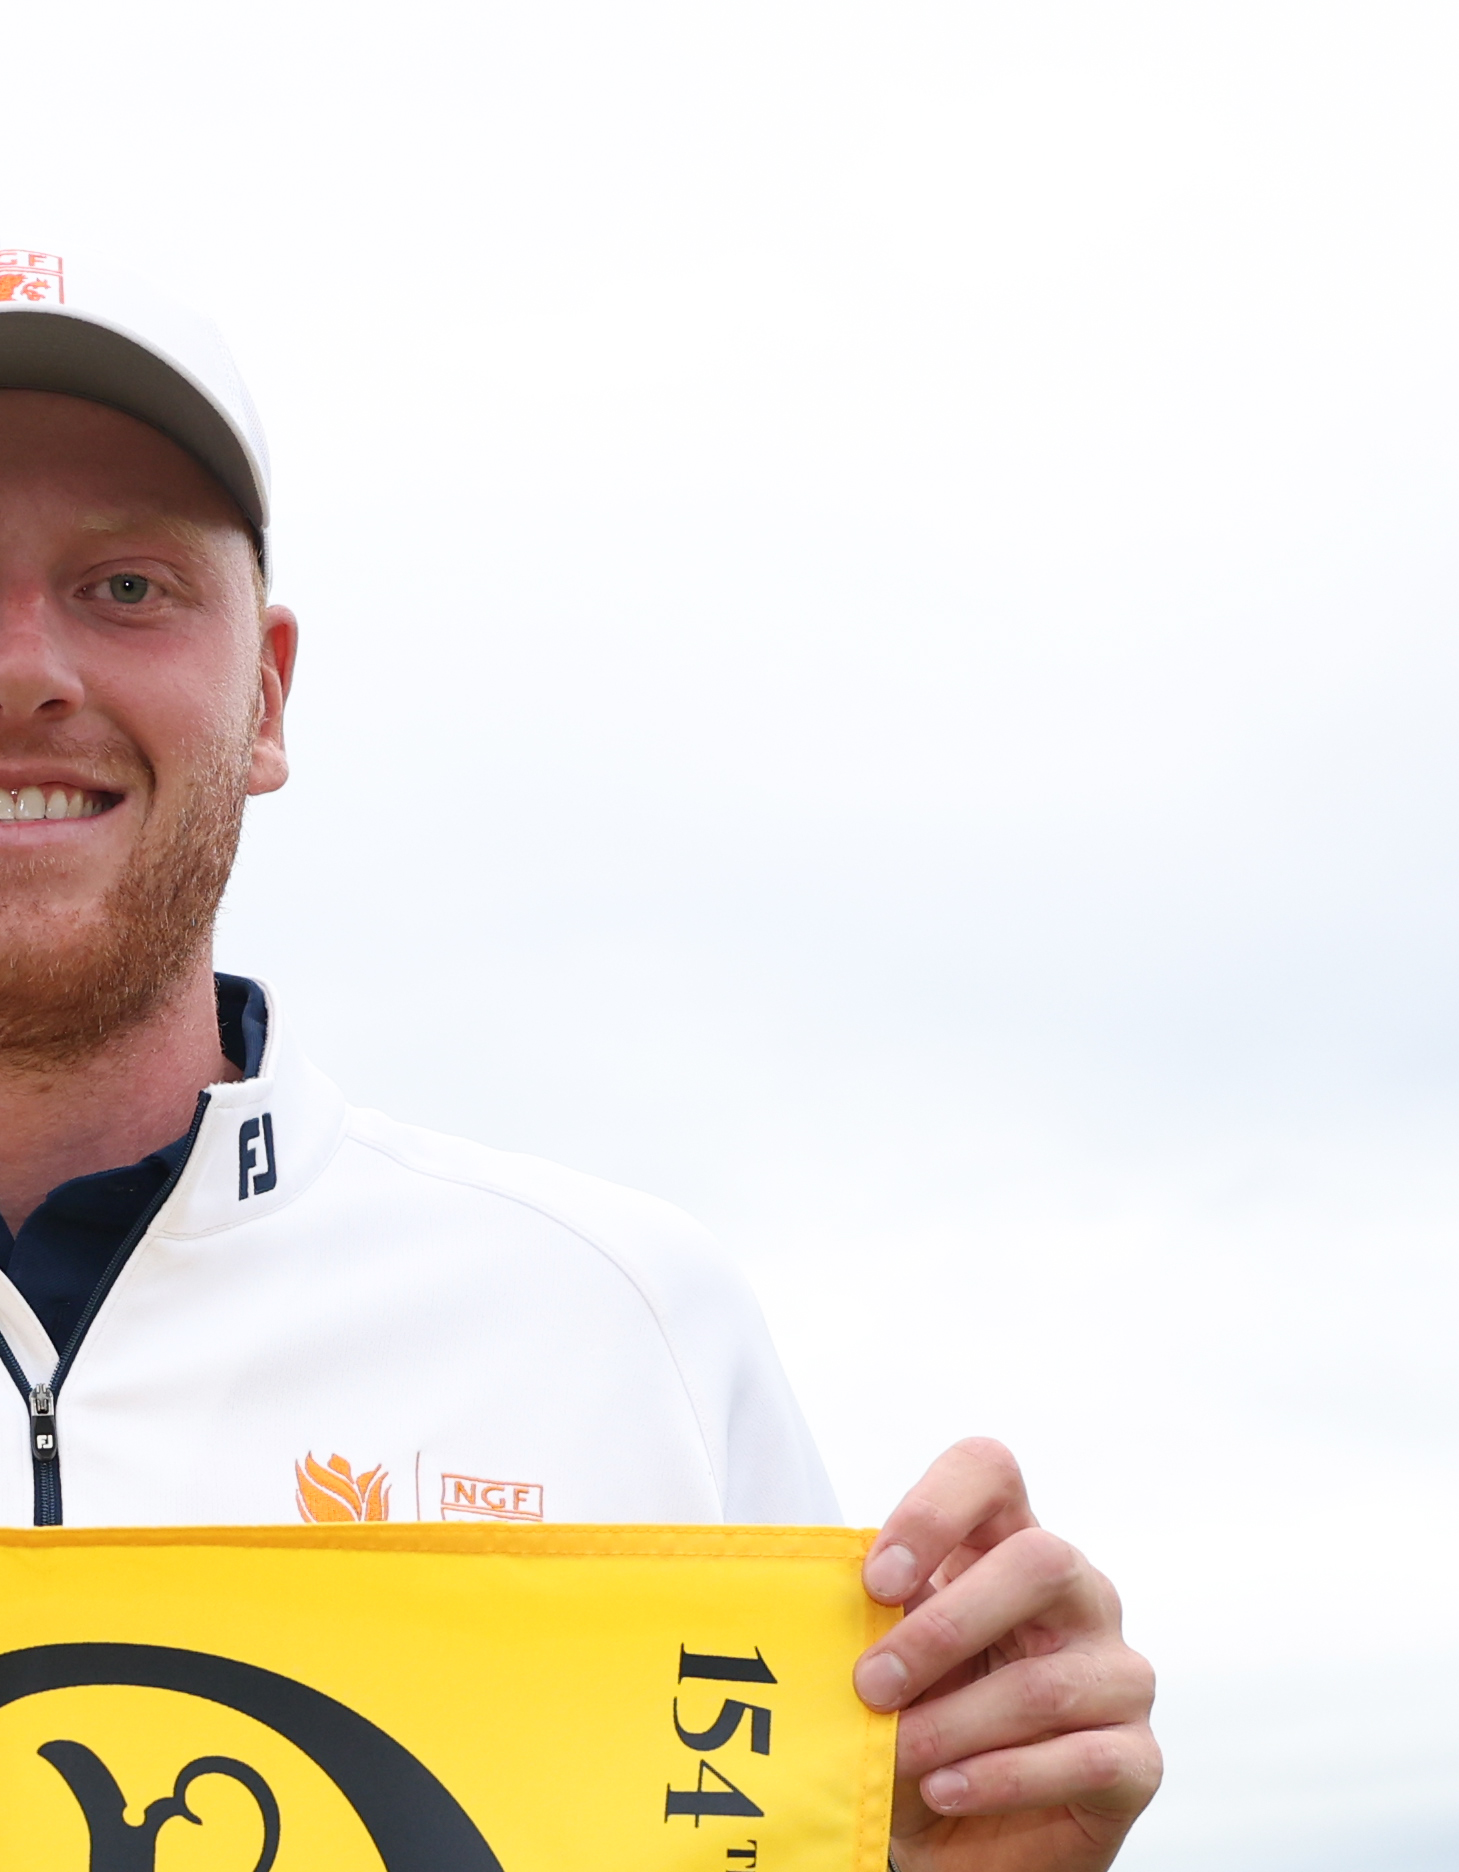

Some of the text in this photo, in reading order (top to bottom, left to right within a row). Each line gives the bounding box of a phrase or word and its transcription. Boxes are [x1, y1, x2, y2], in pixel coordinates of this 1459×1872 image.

[238, 1112, 277, 1201] FJ
[36, 1434, 54, 1450] FJ
[454, 1480, 530, 1510] NGF
